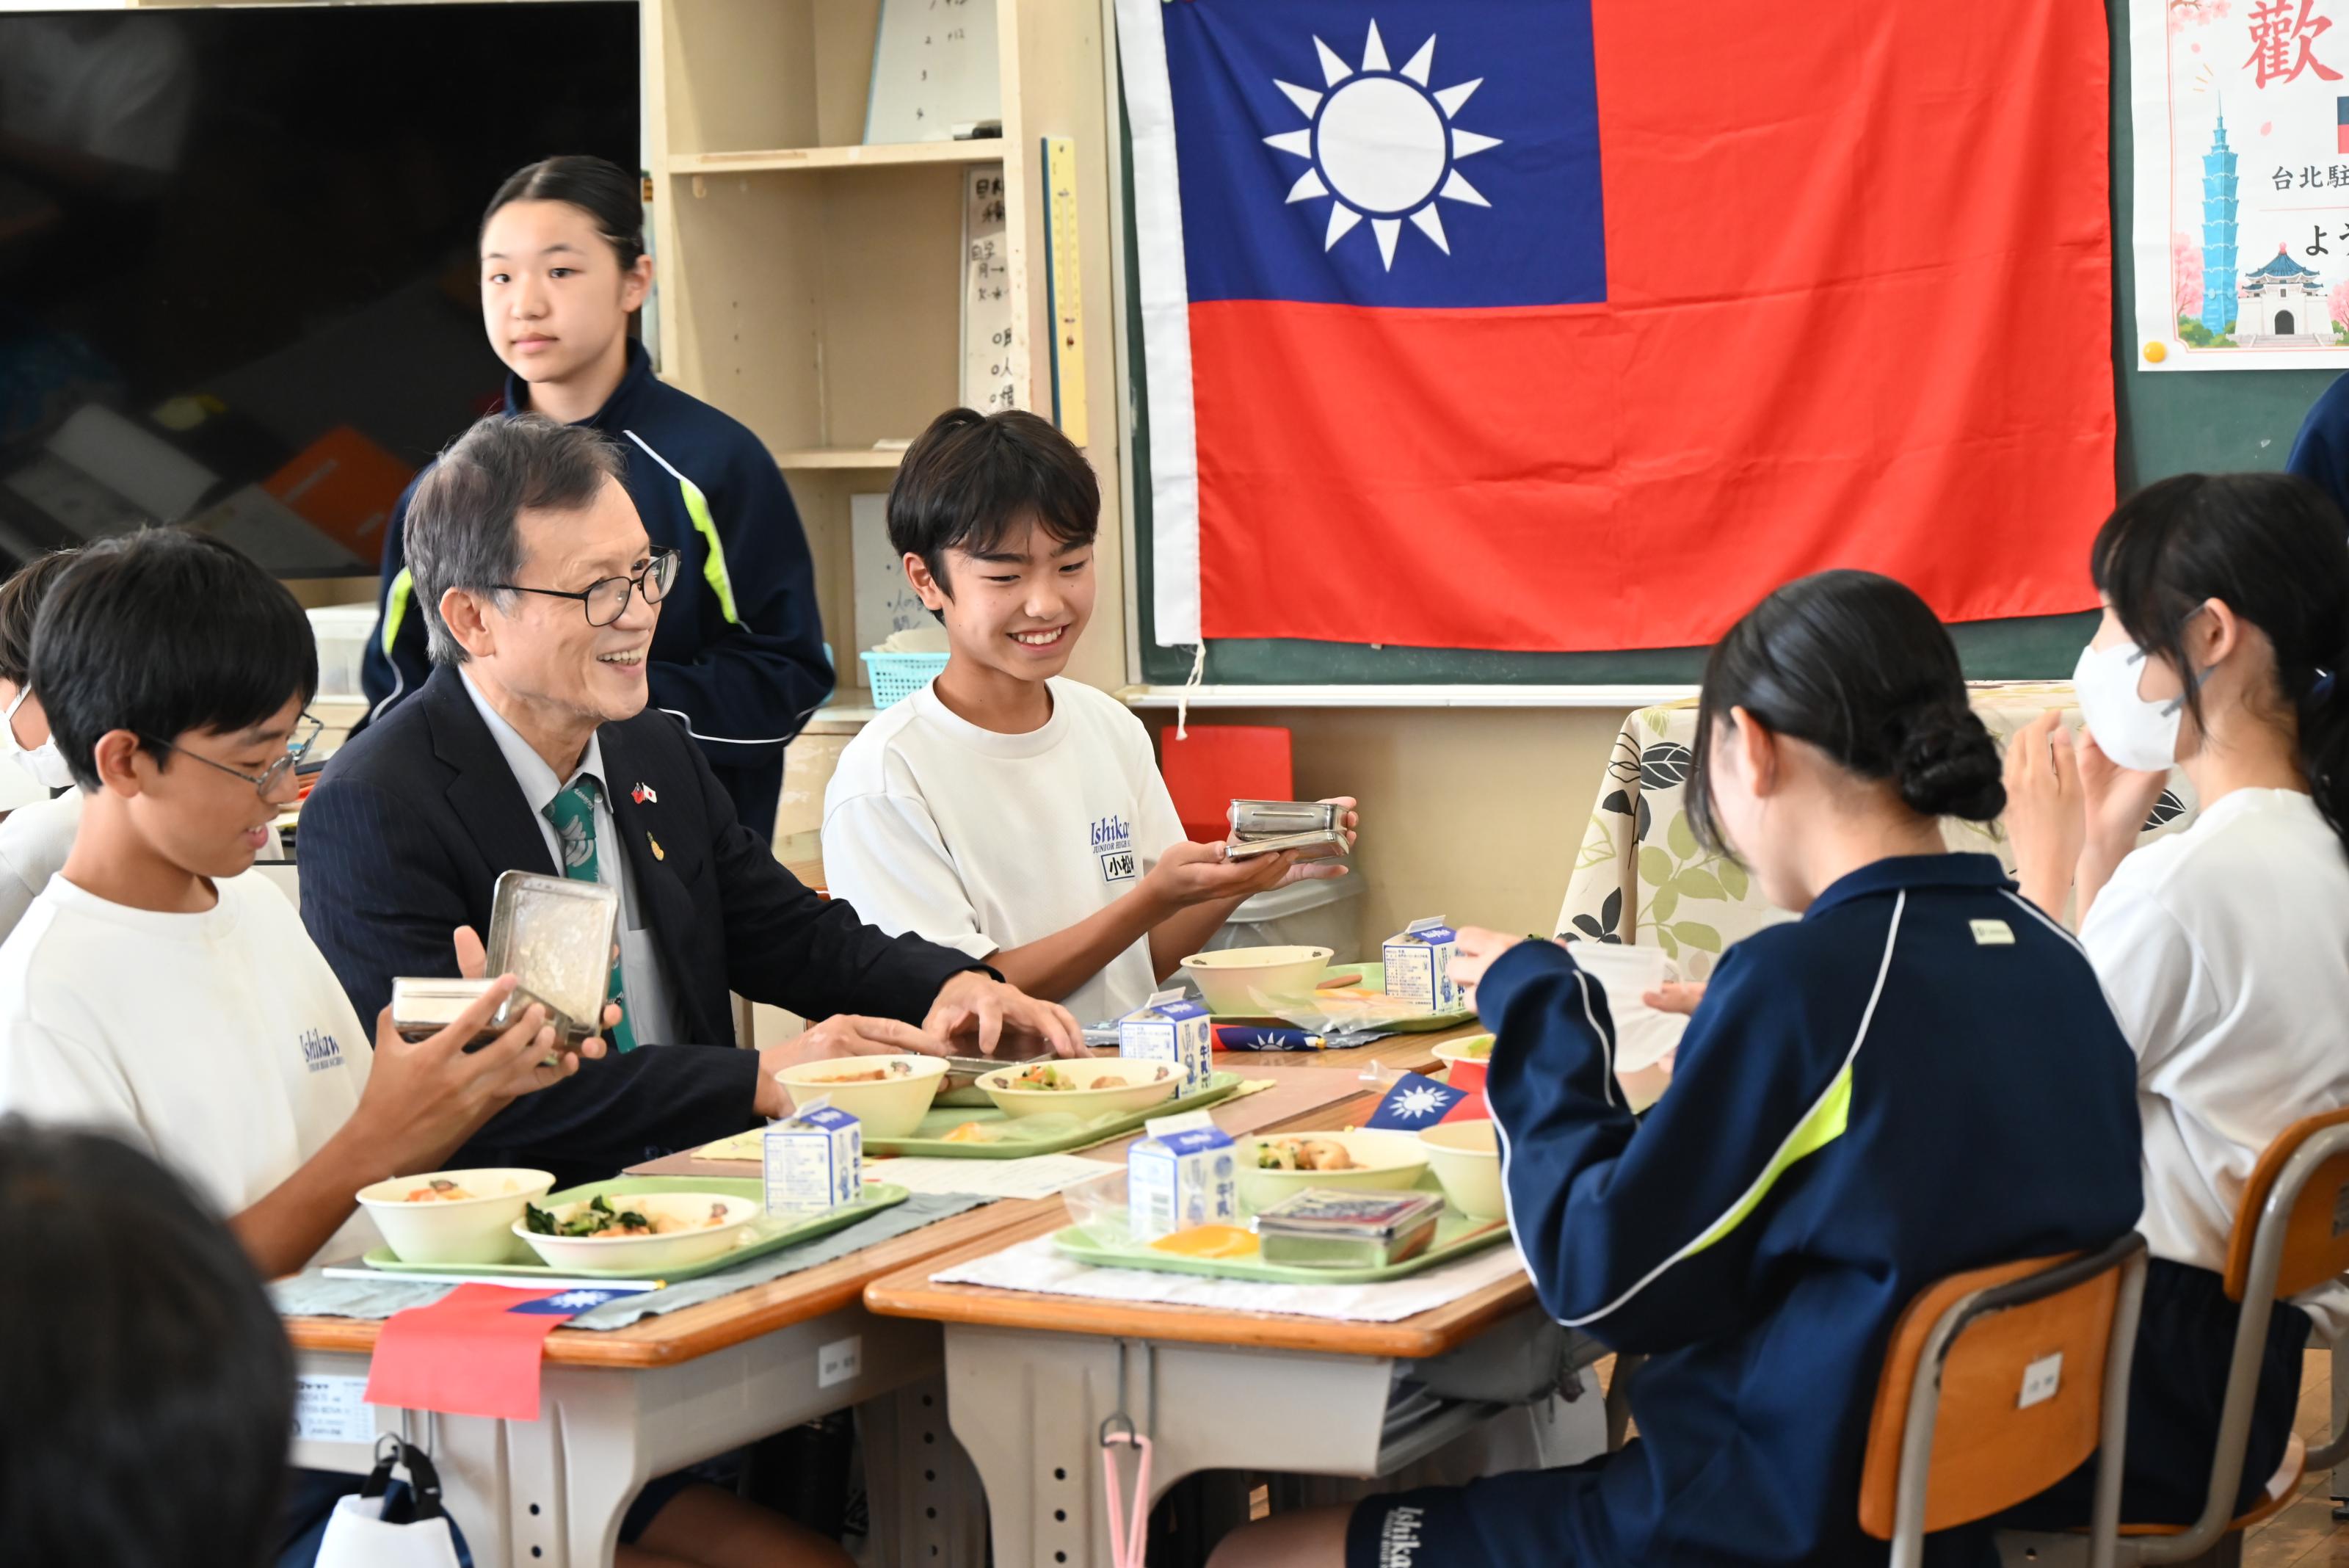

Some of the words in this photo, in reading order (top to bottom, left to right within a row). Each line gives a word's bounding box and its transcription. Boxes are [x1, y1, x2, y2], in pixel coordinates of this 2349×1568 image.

[2241, 0, 2344, 90] 歡
[2272, 164, 2349, 191] 台北駐
[1091, 815, 1129, 846] Ishika
[1093, 843, 1114, 854] JUNIOR
